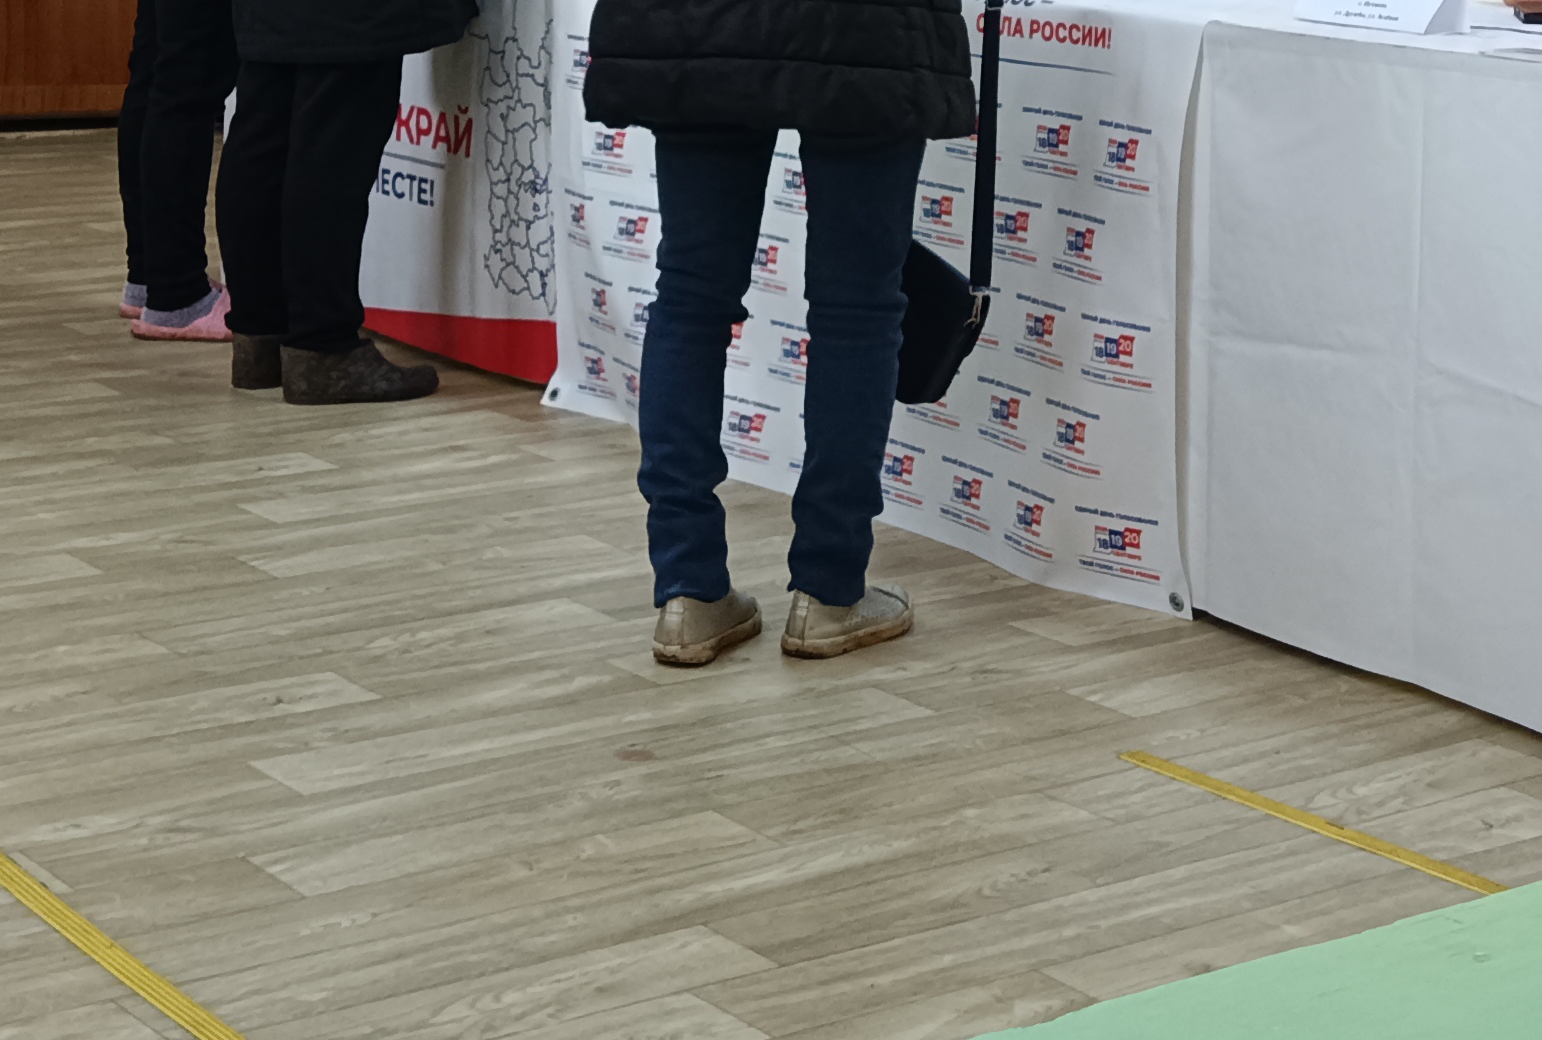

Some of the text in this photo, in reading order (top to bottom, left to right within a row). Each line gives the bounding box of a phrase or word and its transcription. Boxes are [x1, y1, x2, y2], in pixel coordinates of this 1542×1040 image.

[976, 12, 1112, 50] СЛА РОССИИ!
[396, 103, 473, 159] КРАЙ
[376, 168, 435, 207] ЕСТЕ!
[1124, 531, 1139, 545] 20
